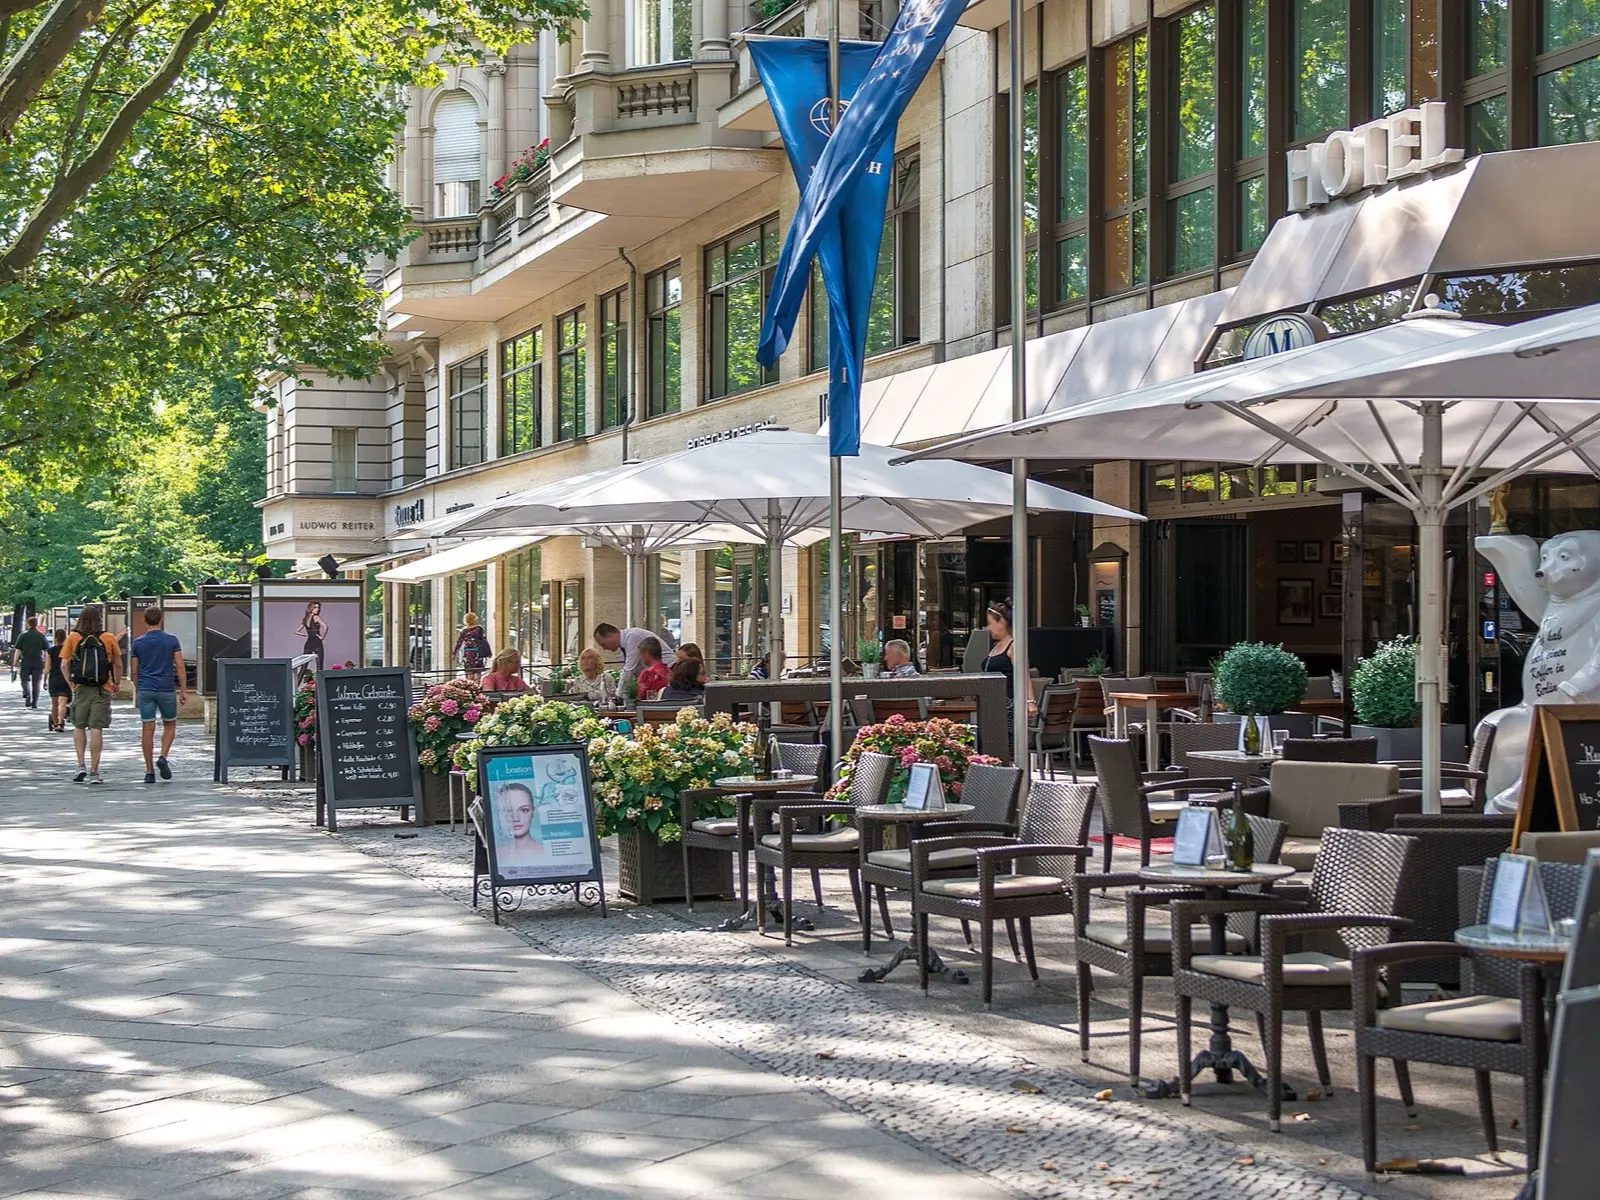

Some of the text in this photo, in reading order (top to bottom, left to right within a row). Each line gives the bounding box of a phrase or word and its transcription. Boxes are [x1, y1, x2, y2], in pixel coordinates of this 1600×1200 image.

[1287, 101, 1465, 212] HOTEL
[300, 521, 375, 530] LUDWIG REITER
[1546, 648, 1568, 660] einen
[1530, 662, 1565, 682] Koffer in
[336, 685, 362, 700] Warme
[1535, 681, 1559, 698] Berlin
